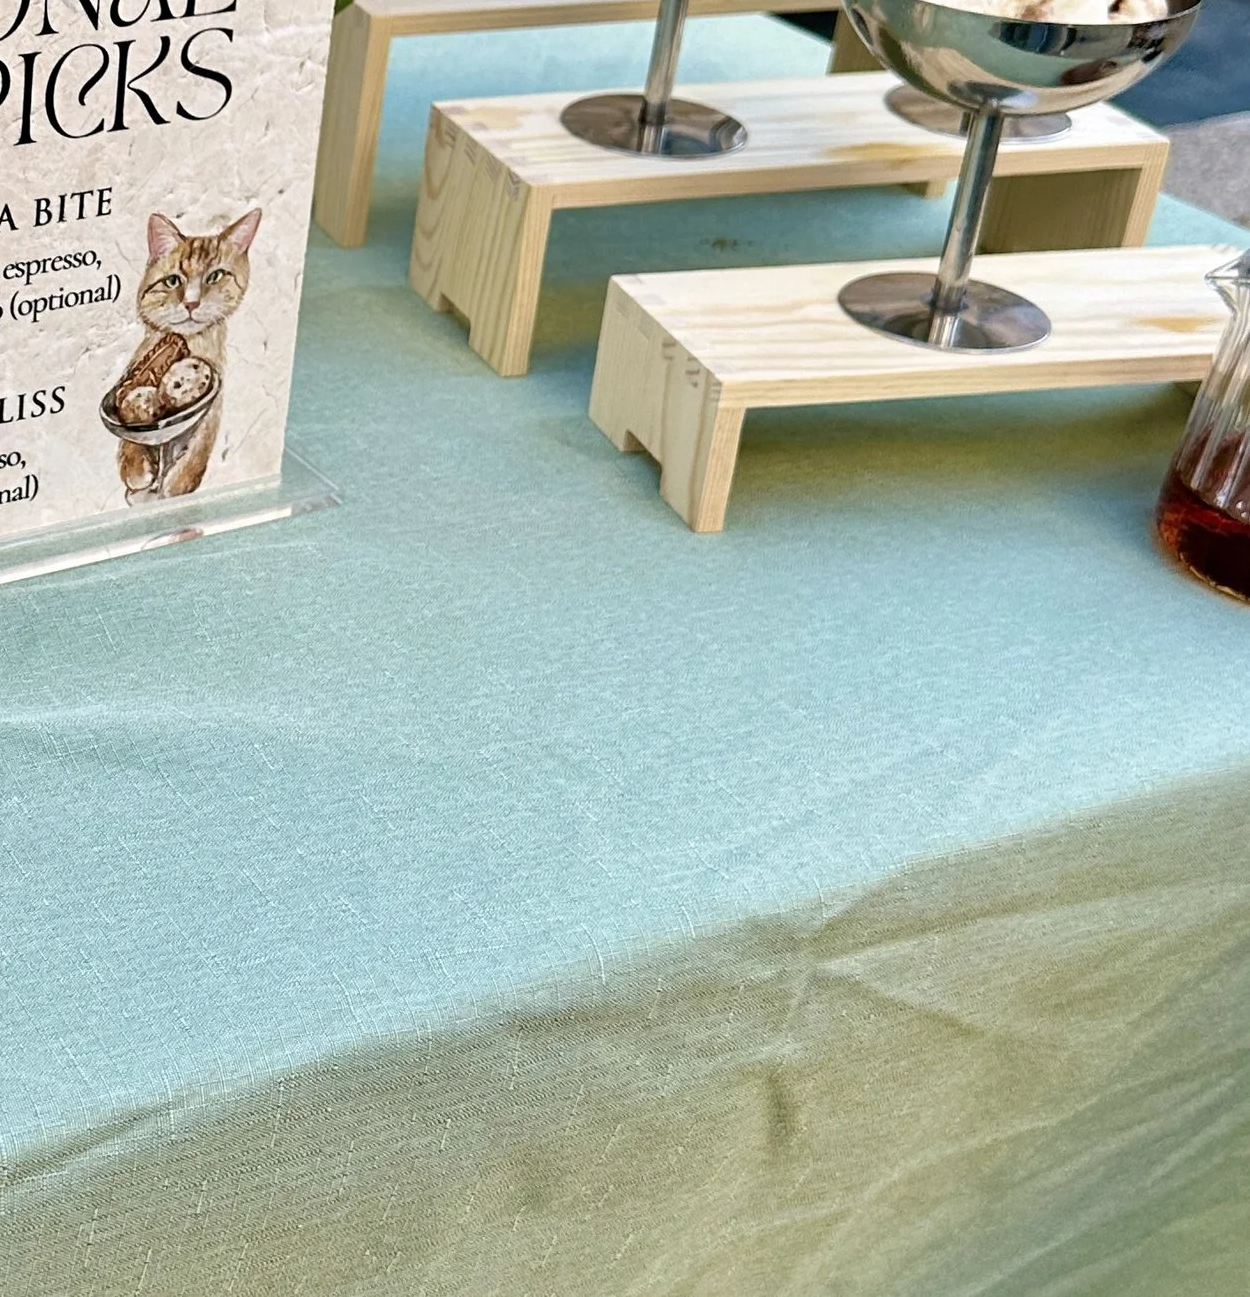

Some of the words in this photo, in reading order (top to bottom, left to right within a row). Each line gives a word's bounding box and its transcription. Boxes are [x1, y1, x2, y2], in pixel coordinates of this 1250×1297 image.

[33, 187, 112, 227] BITE
[3, 251, 101, 291] espresso,
[10, 274, 121, 323] (optional)
